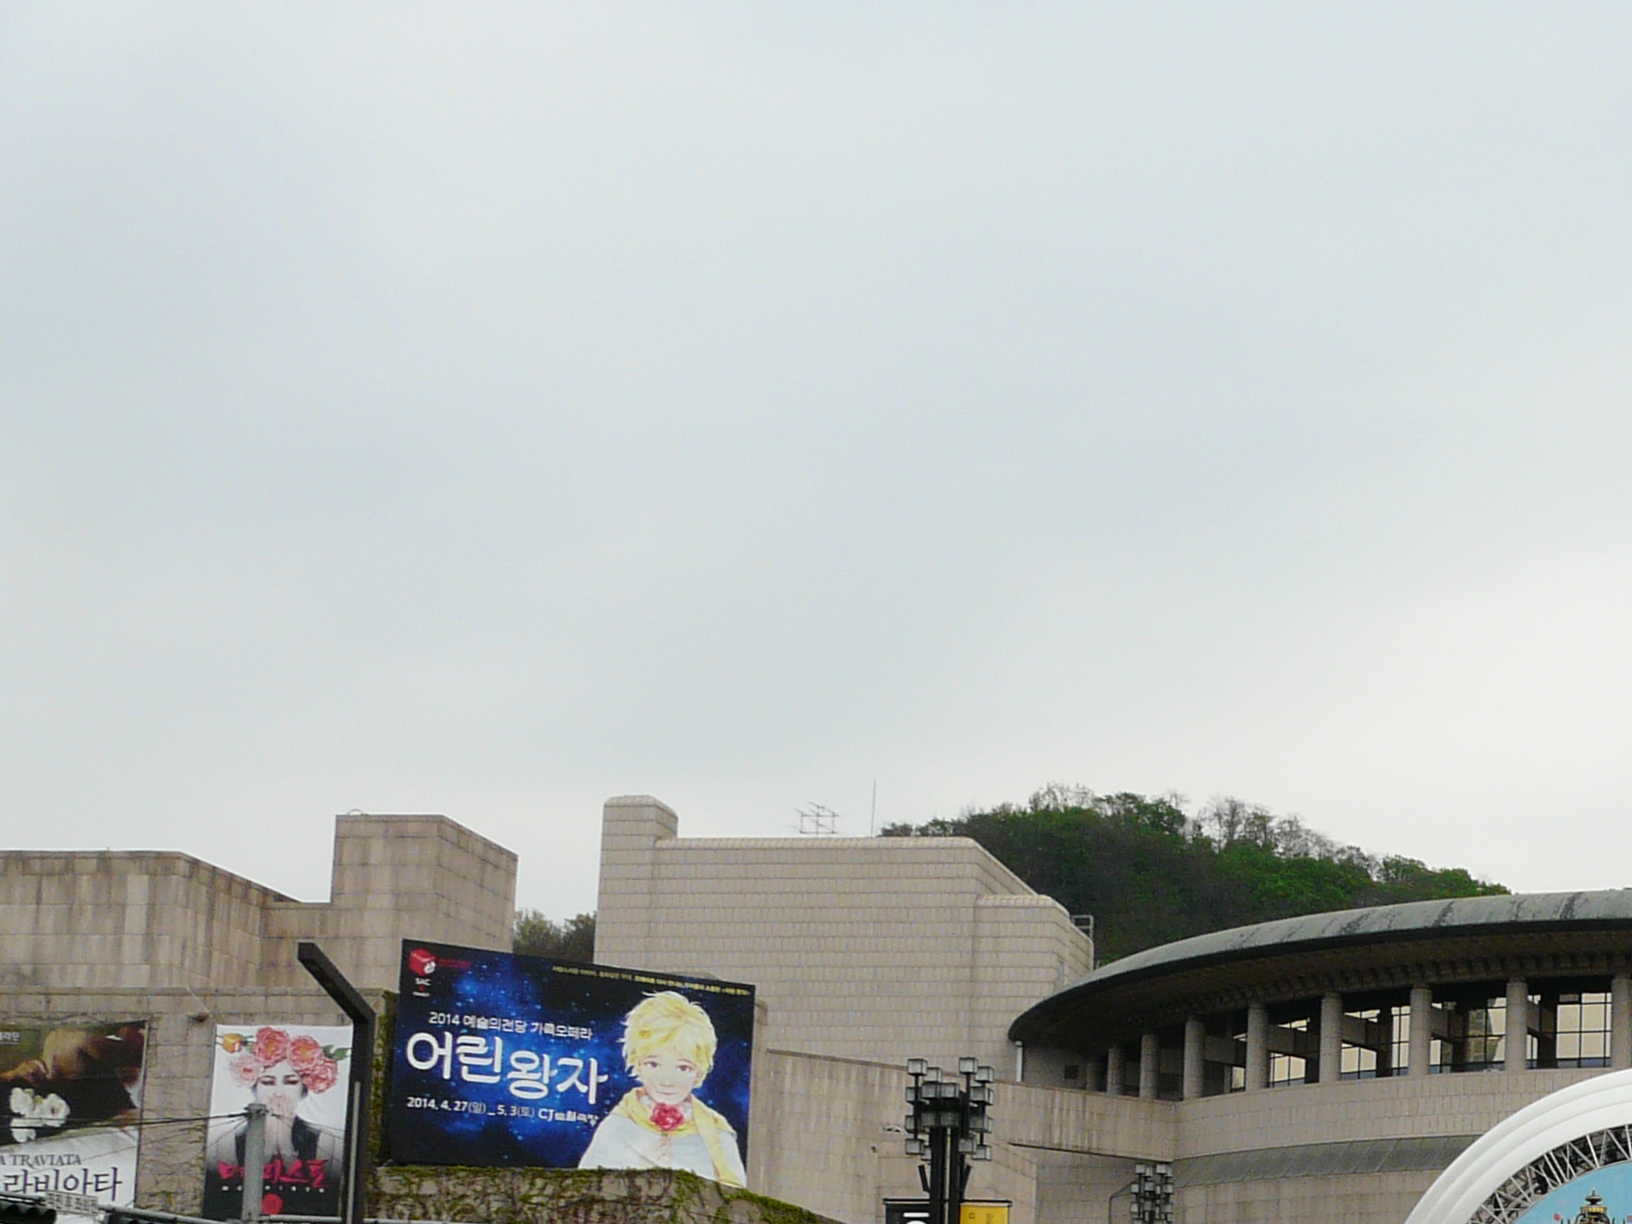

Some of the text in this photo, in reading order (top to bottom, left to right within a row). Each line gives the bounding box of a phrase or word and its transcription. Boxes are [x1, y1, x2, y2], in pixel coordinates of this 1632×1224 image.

[429, 1011, 460, 1025] 2014
[463, 1014, 527, 1033] 예술의전당
[10, 1154, 82, 1170] TRAVIATA
